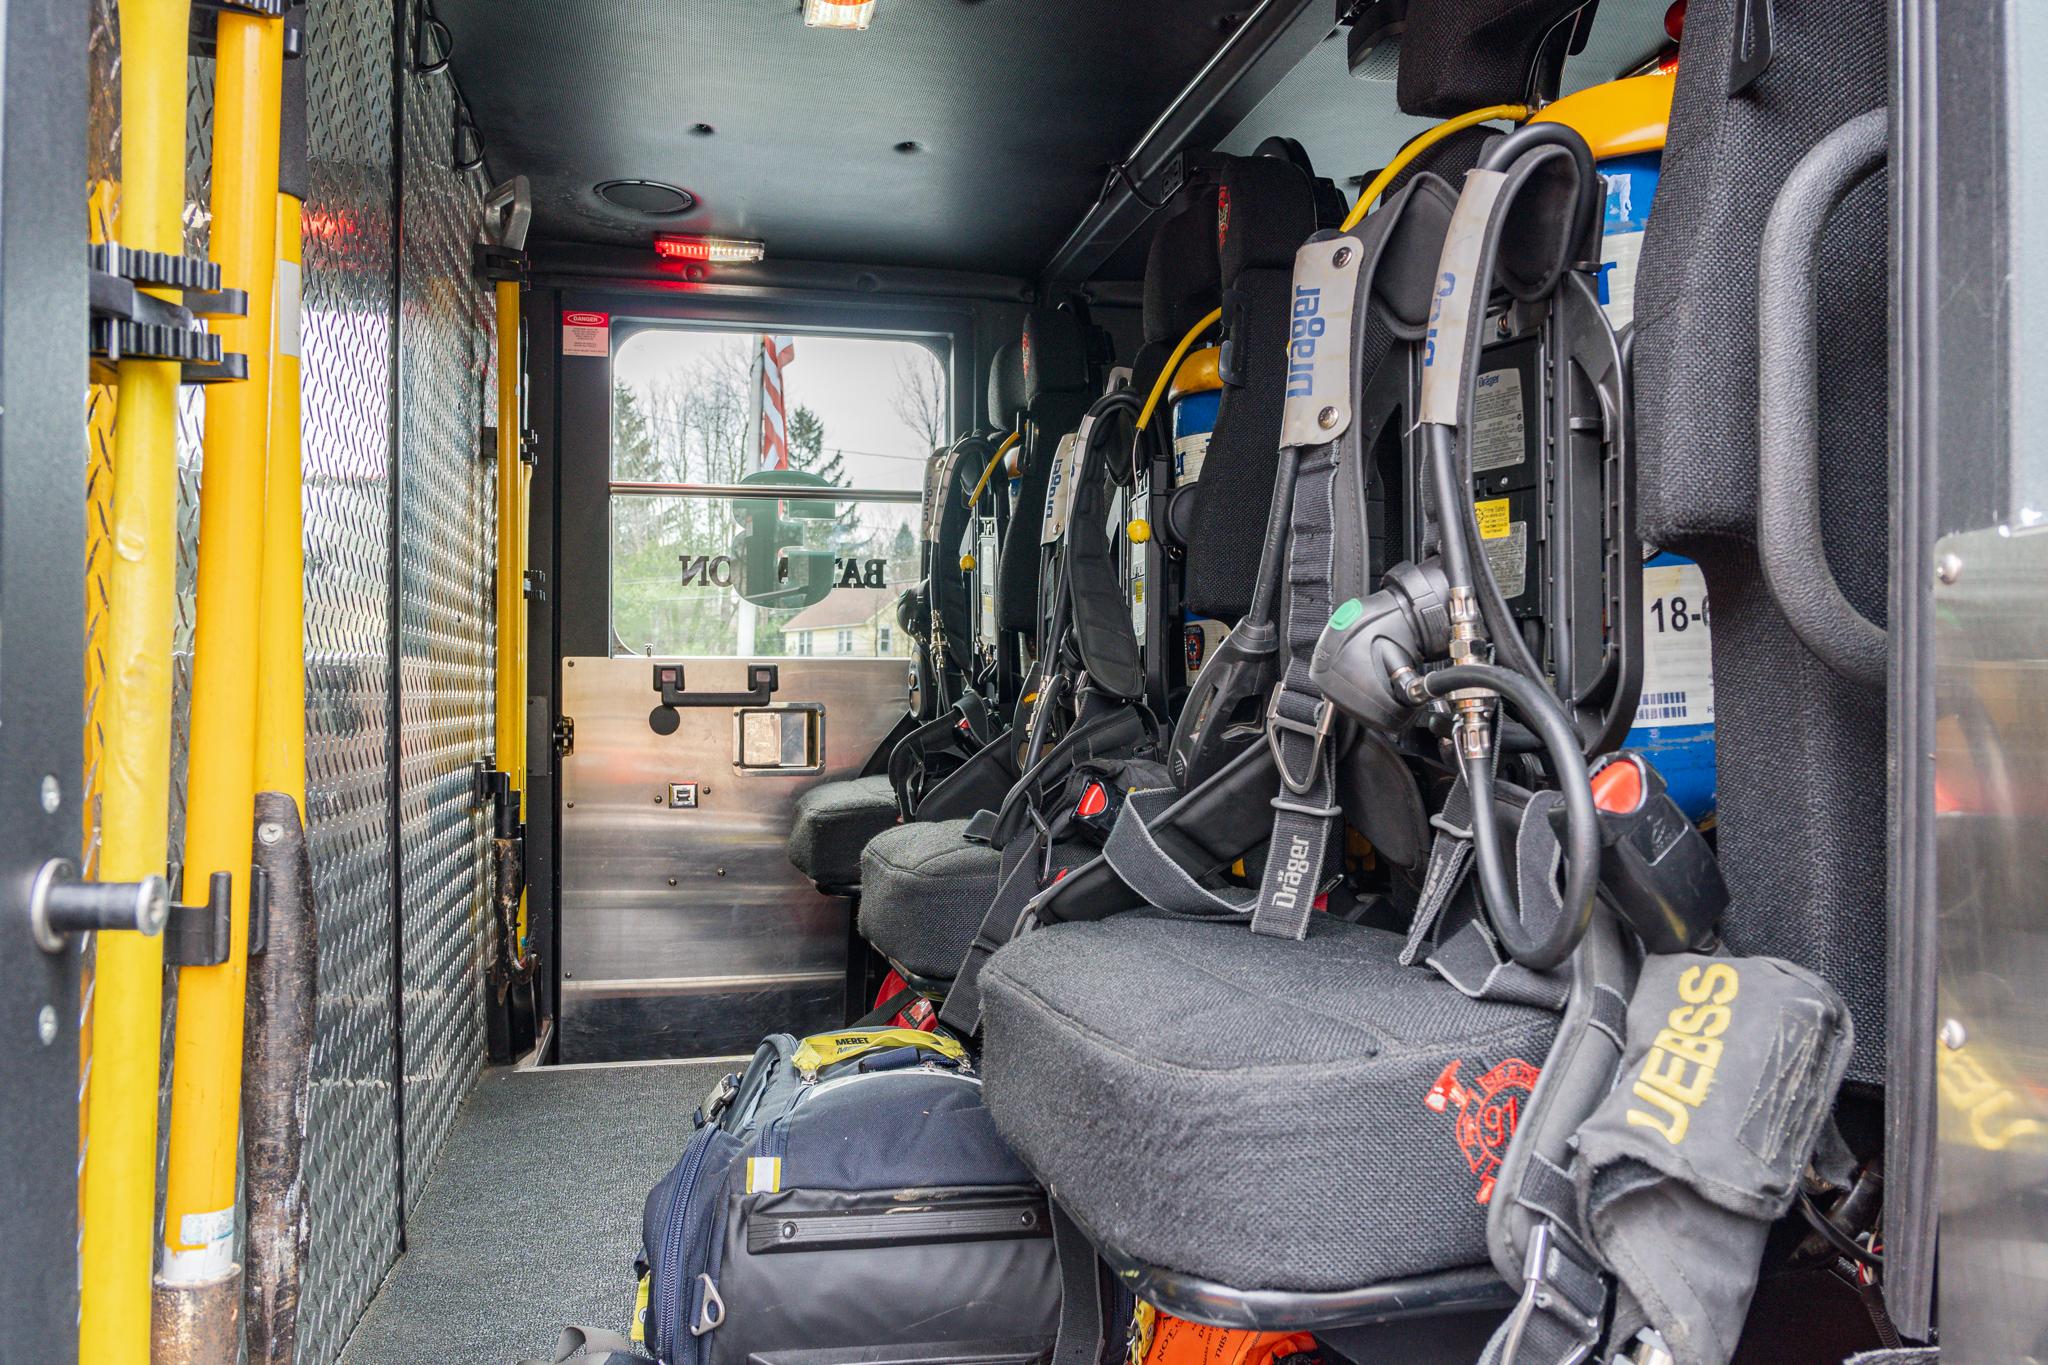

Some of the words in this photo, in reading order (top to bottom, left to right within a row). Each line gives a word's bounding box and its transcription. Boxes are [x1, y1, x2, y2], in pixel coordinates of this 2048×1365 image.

[1272, 835, 1309, 909] Dräger
[836, 1037, 869, 1046] MERET
[1627, 963, 1738, 1145] UEBSS
[1484, 1096, 1518, 1147] 91
[1157, 1329, 1178, 1362] NOT
[1215, 1335, 1227, 1359] THIS
